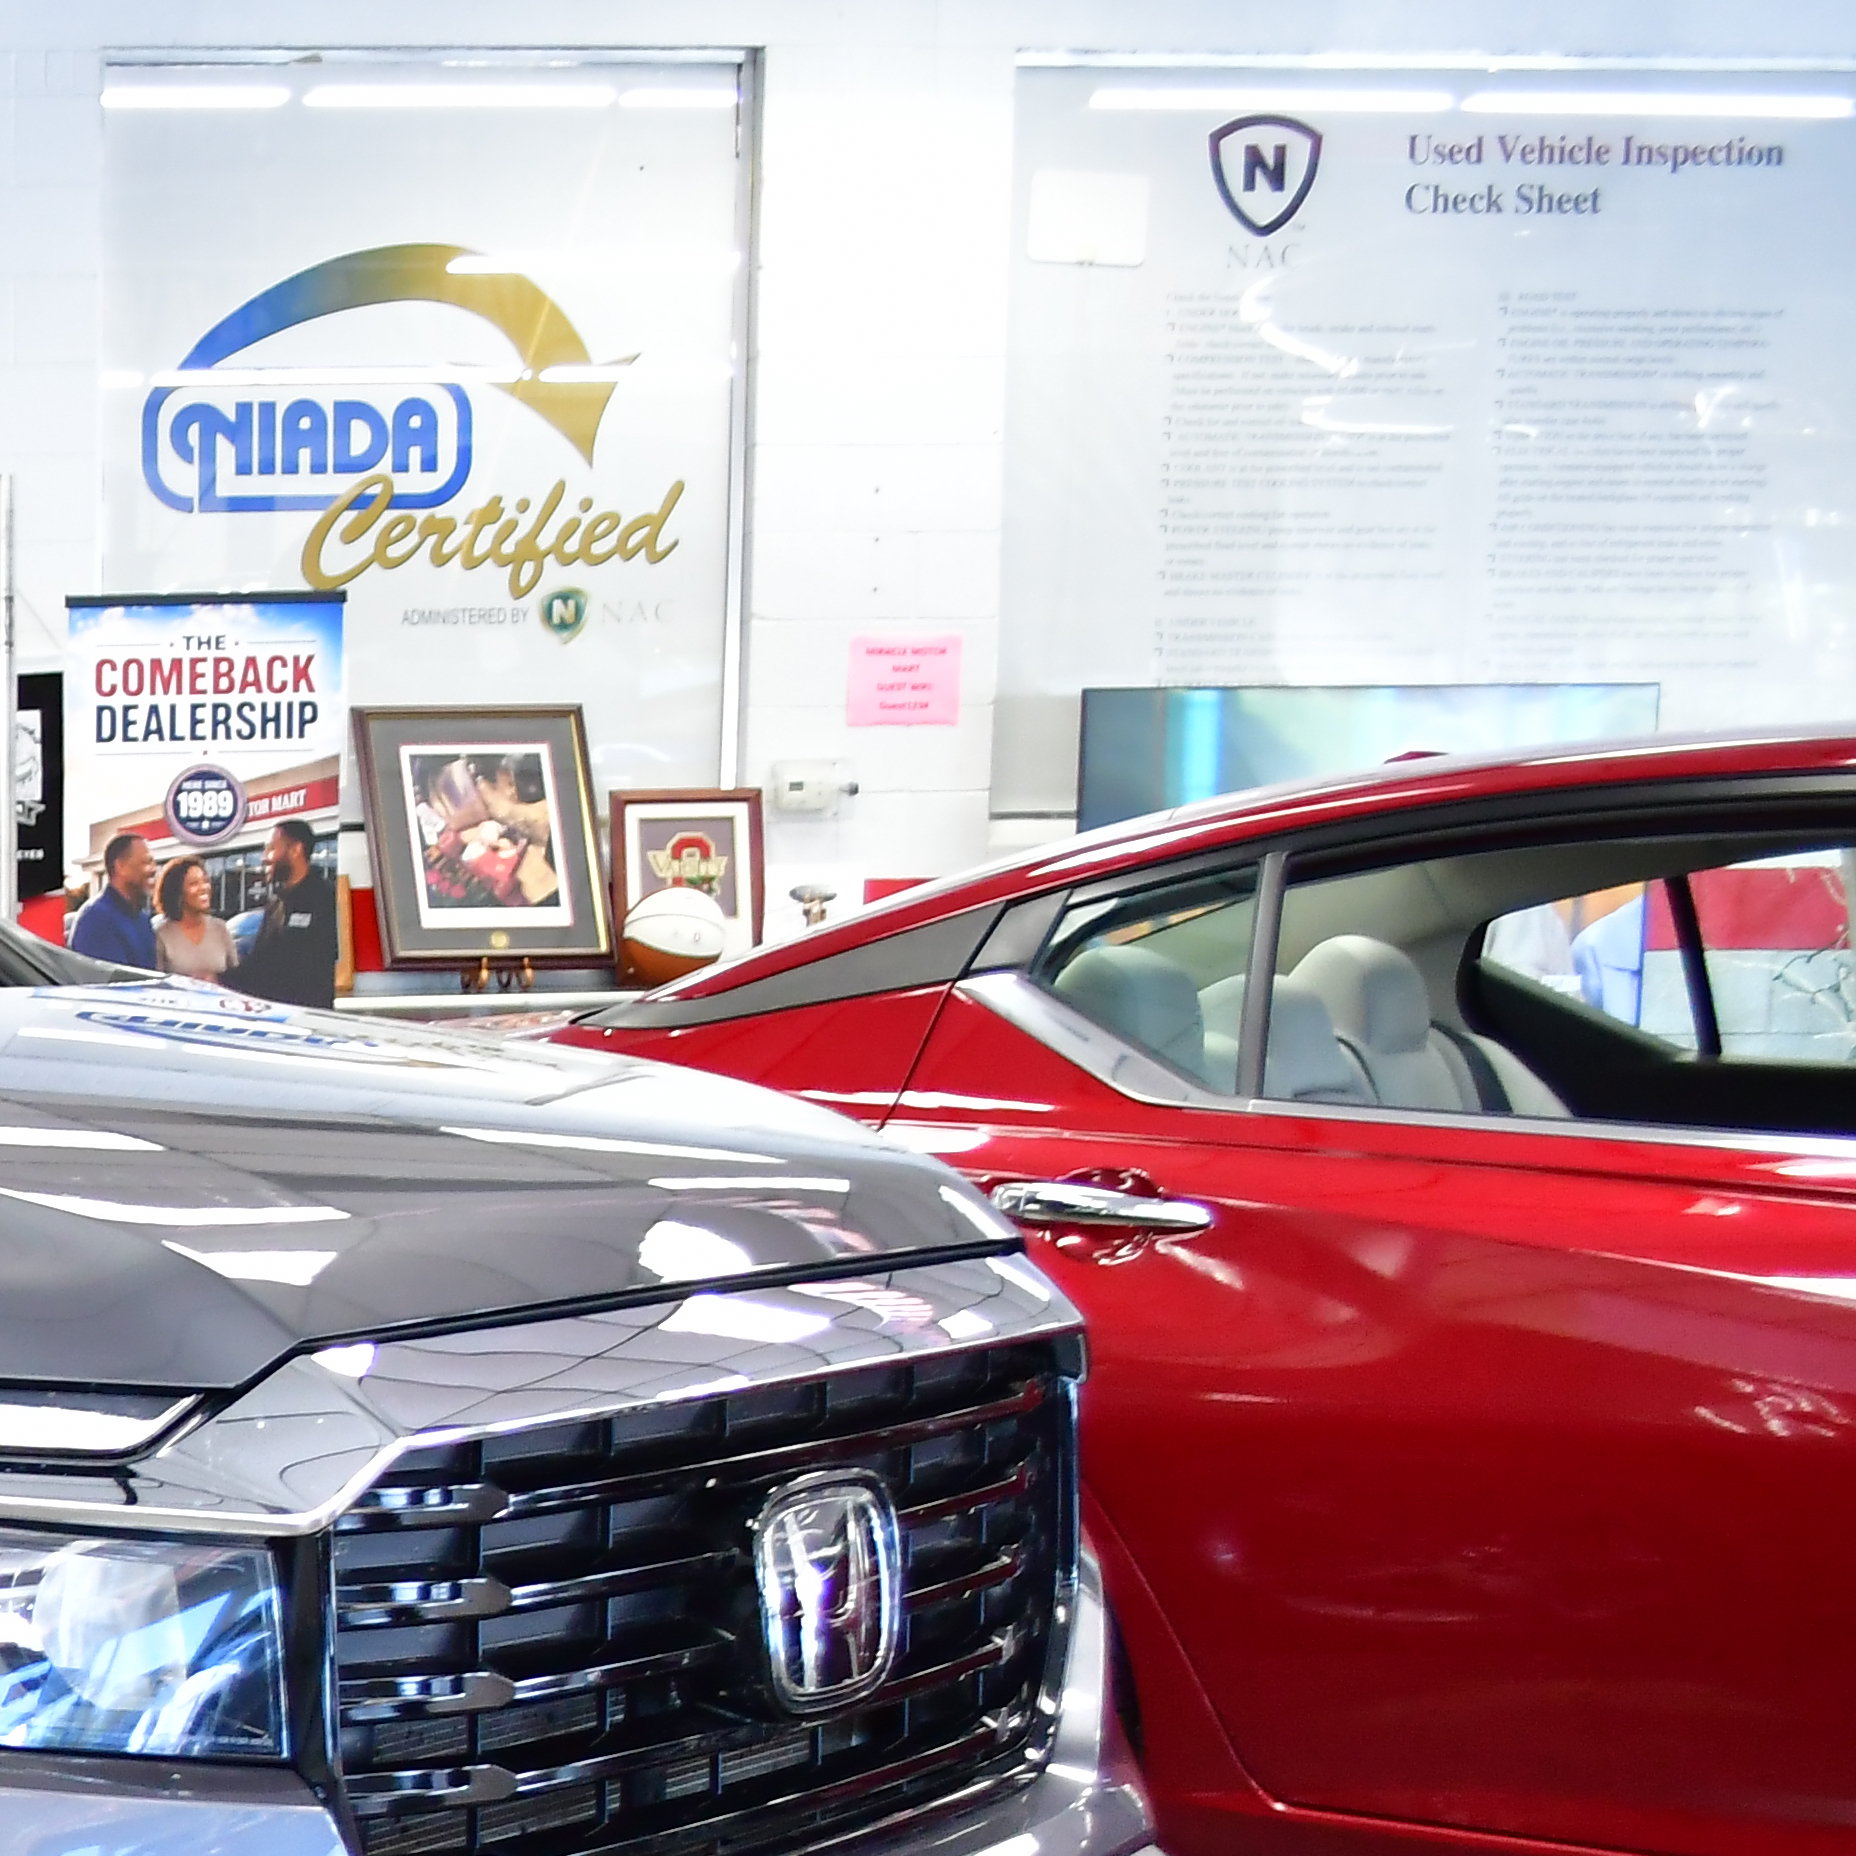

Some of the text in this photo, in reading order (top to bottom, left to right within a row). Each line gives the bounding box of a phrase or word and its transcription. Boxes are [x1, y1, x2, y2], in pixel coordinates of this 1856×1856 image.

[1406, 133, 1786, 177] Used Vehicle Inspection
[1404, 182, 1603, 218] Check Sheet
[168, 396, 439, 478] NIADA
[300, 474, 685, 600] Certified
[401, 607, 506, 626] ADMINISTERED
[511, 607, 531, 625] BY
[182, 635, 227, 651] THE
[94, 653, 317, 698] COMEBACK
[95, 700, 319, 744] DEALERSHIP
[176, 790, 234, 819] 1989
[247, 789, 307, 818] TOR MART
